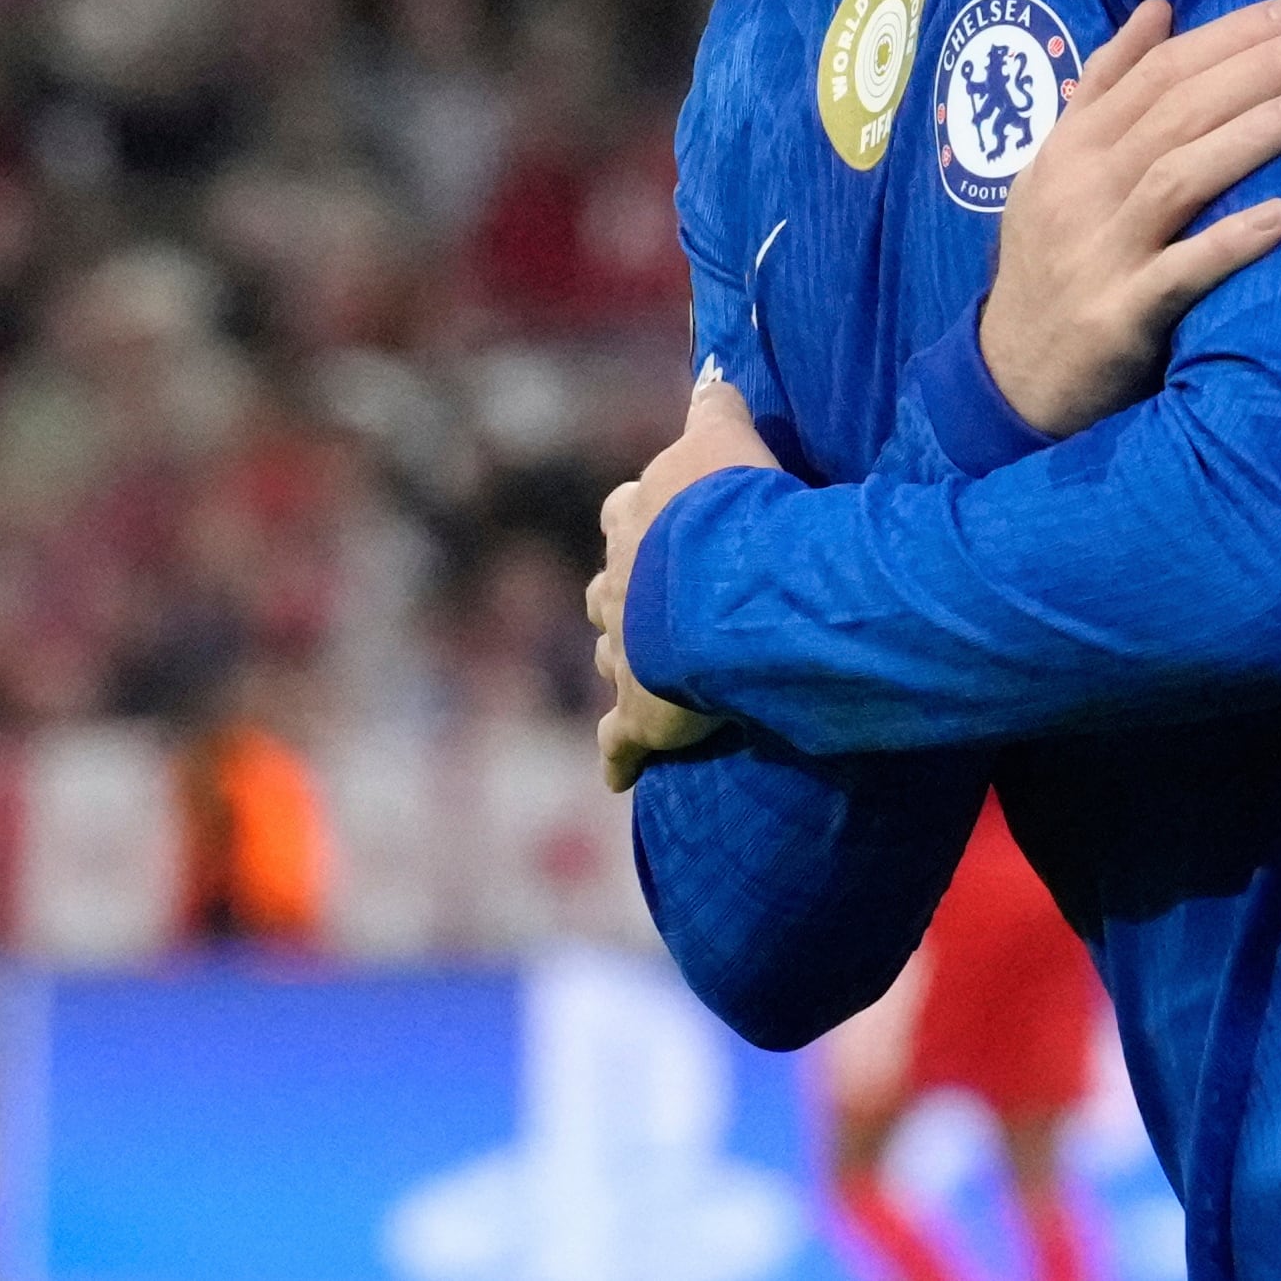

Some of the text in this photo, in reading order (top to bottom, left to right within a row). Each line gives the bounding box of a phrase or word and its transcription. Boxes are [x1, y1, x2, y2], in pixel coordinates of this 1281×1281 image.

[943, 0, 1032, 72] CHELSEA
[860, 107, 895, 155] FIFA
[960, 180, 1008, 200] FOOTB
